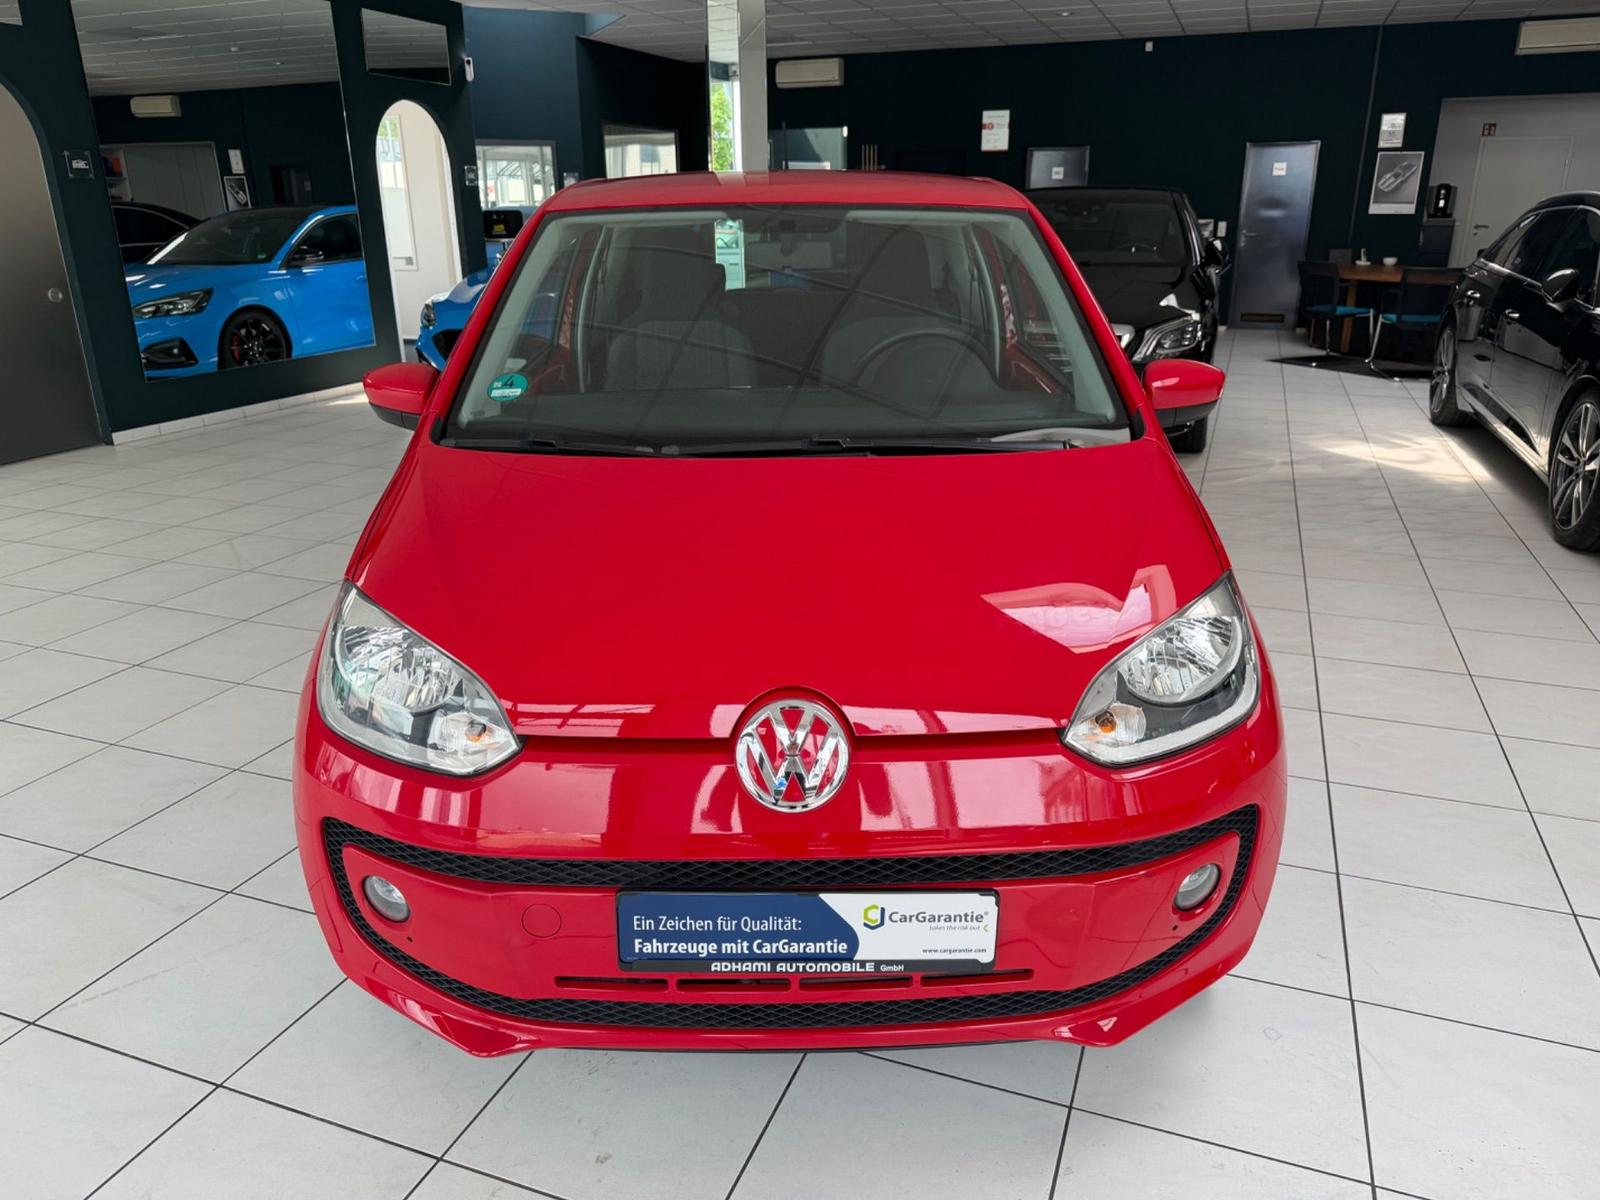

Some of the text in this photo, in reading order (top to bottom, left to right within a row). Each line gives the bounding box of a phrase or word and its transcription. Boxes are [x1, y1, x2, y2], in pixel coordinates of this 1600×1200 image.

[502, 375, 515, 388] 4
[736, 699, 849, 813] VW
[633, 915, 802, 933] Ein Zeichen für Qualität:
[634, 938, 848, 957] Fahrzeuge mit CarGarantie
[710, 962, 904, 972] ADHAMI AUTOMOBILE GmbH
